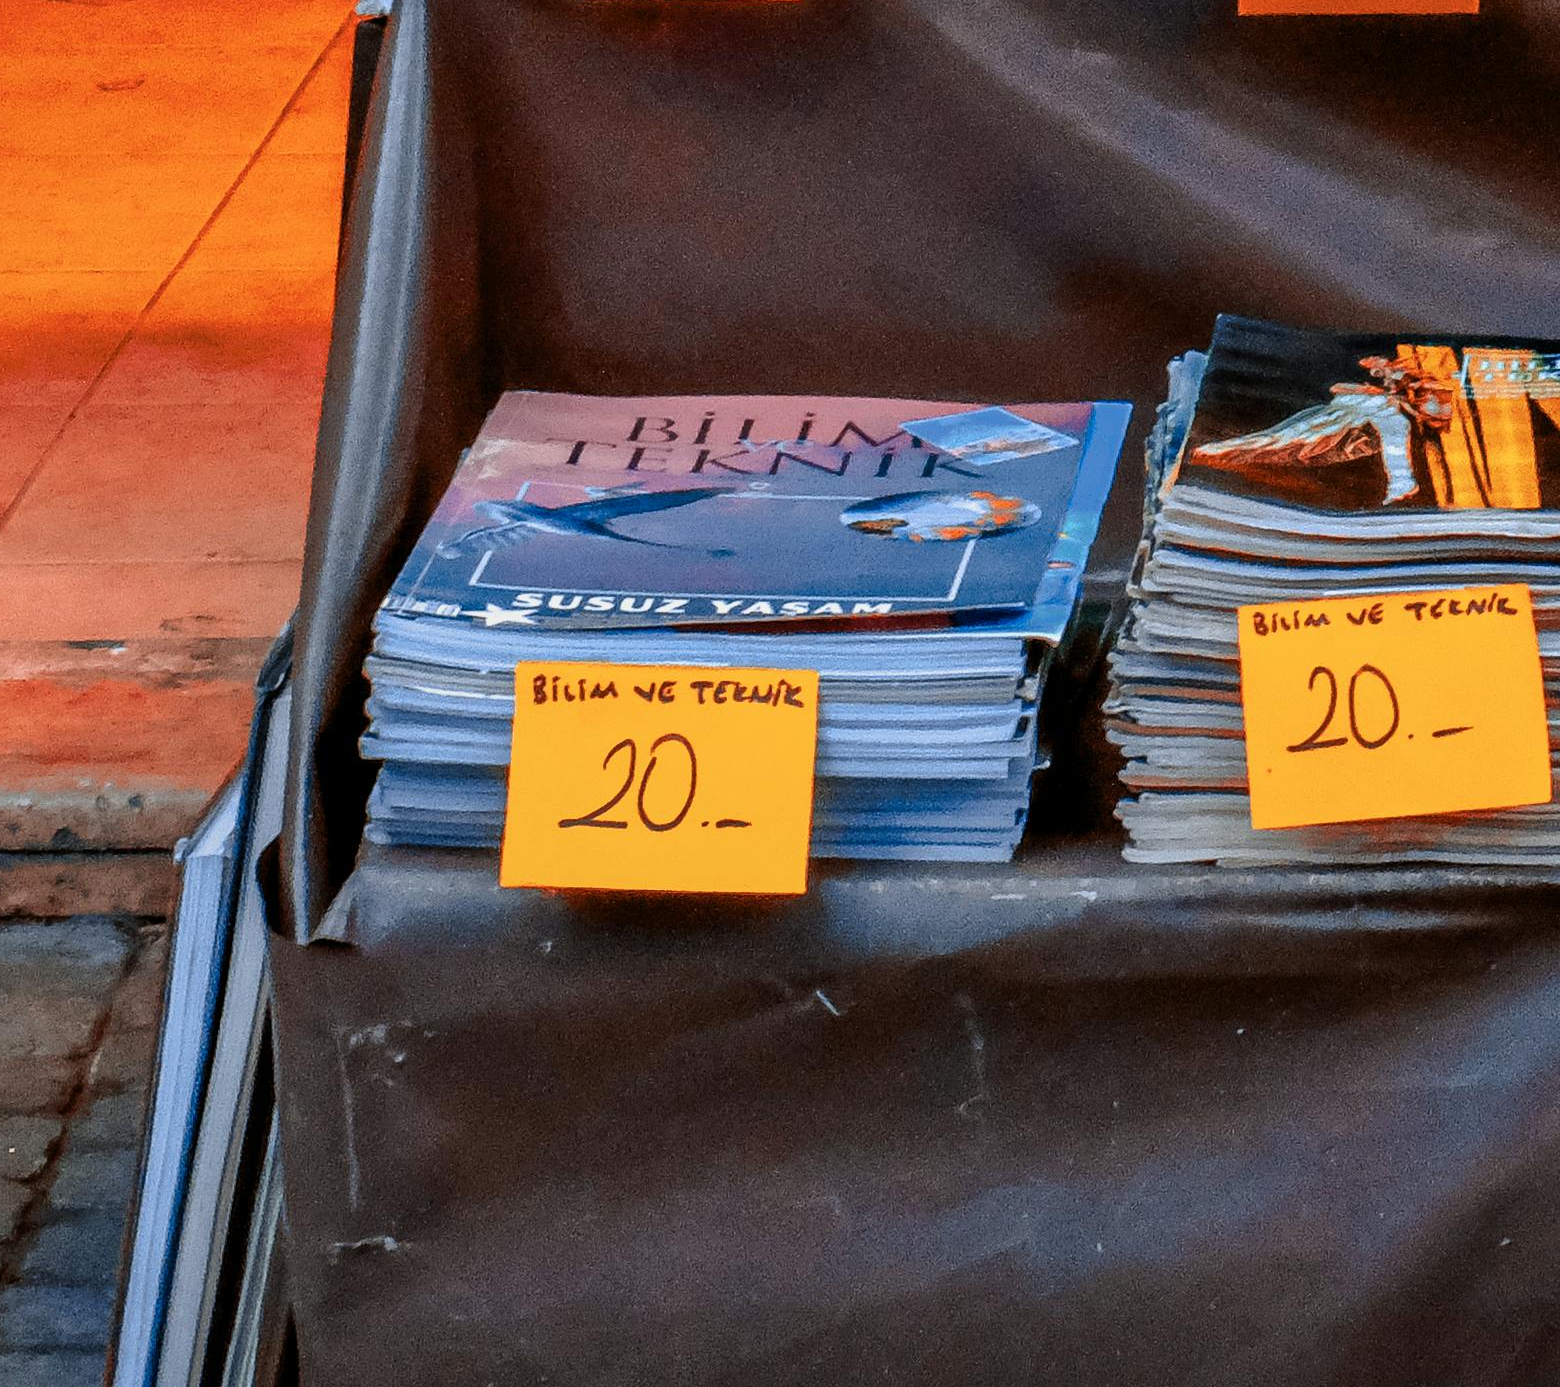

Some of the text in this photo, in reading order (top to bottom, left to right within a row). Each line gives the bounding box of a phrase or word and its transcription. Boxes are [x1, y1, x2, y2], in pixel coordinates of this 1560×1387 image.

[628, 410, 923, 451] BİLİM
[545, 437, 984, 479] TEKNİK
[511, 592, 690, 618] SUSUZ
[1254, 592, 1520, 638] BİLİM VE TEKNİK
[533, 674, 807, 710] BİLİM VE TEKNİK
